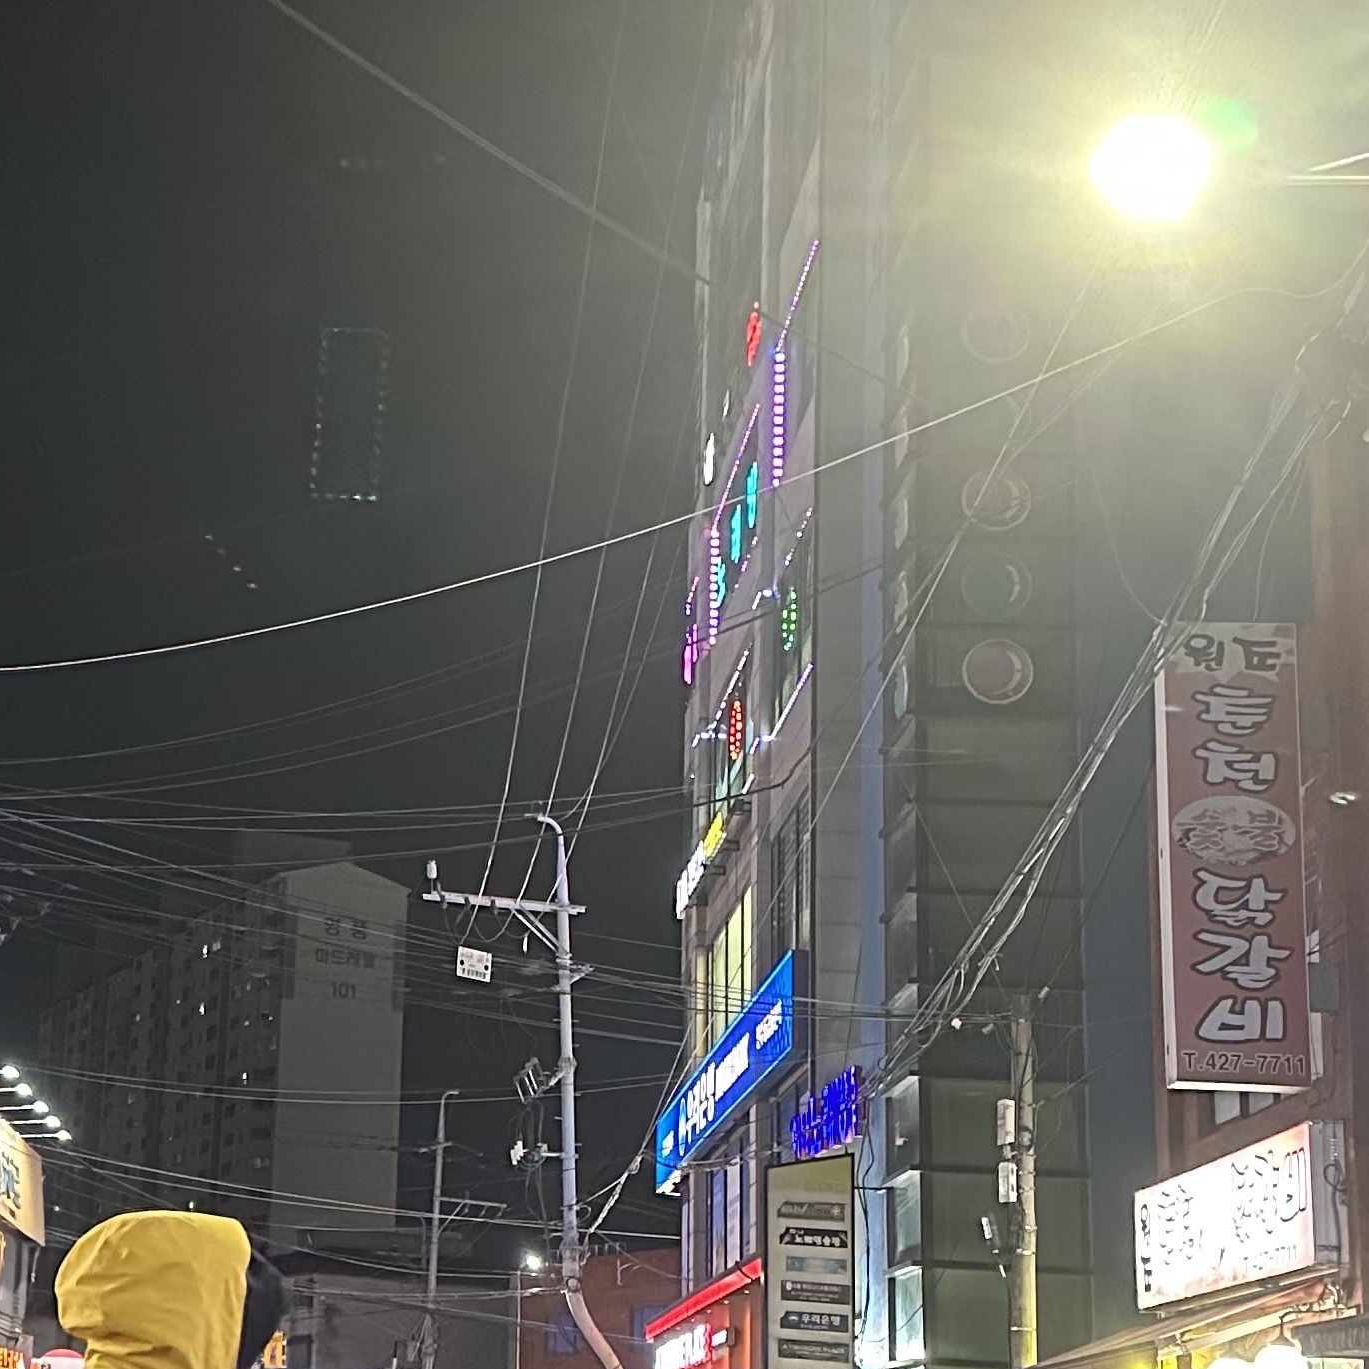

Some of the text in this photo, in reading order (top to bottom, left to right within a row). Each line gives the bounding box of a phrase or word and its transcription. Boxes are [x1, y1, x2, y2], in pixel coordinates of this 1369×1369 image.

[1192, 683, 1277, 793] 춘천
[1191, 868, 1293, 1042] 닭갈비
[332, 981, 356, 999] 101
[1182, 1051, 1306, 1076] T.427-7711
[801, 1313, 841, 1326] 우리은행
